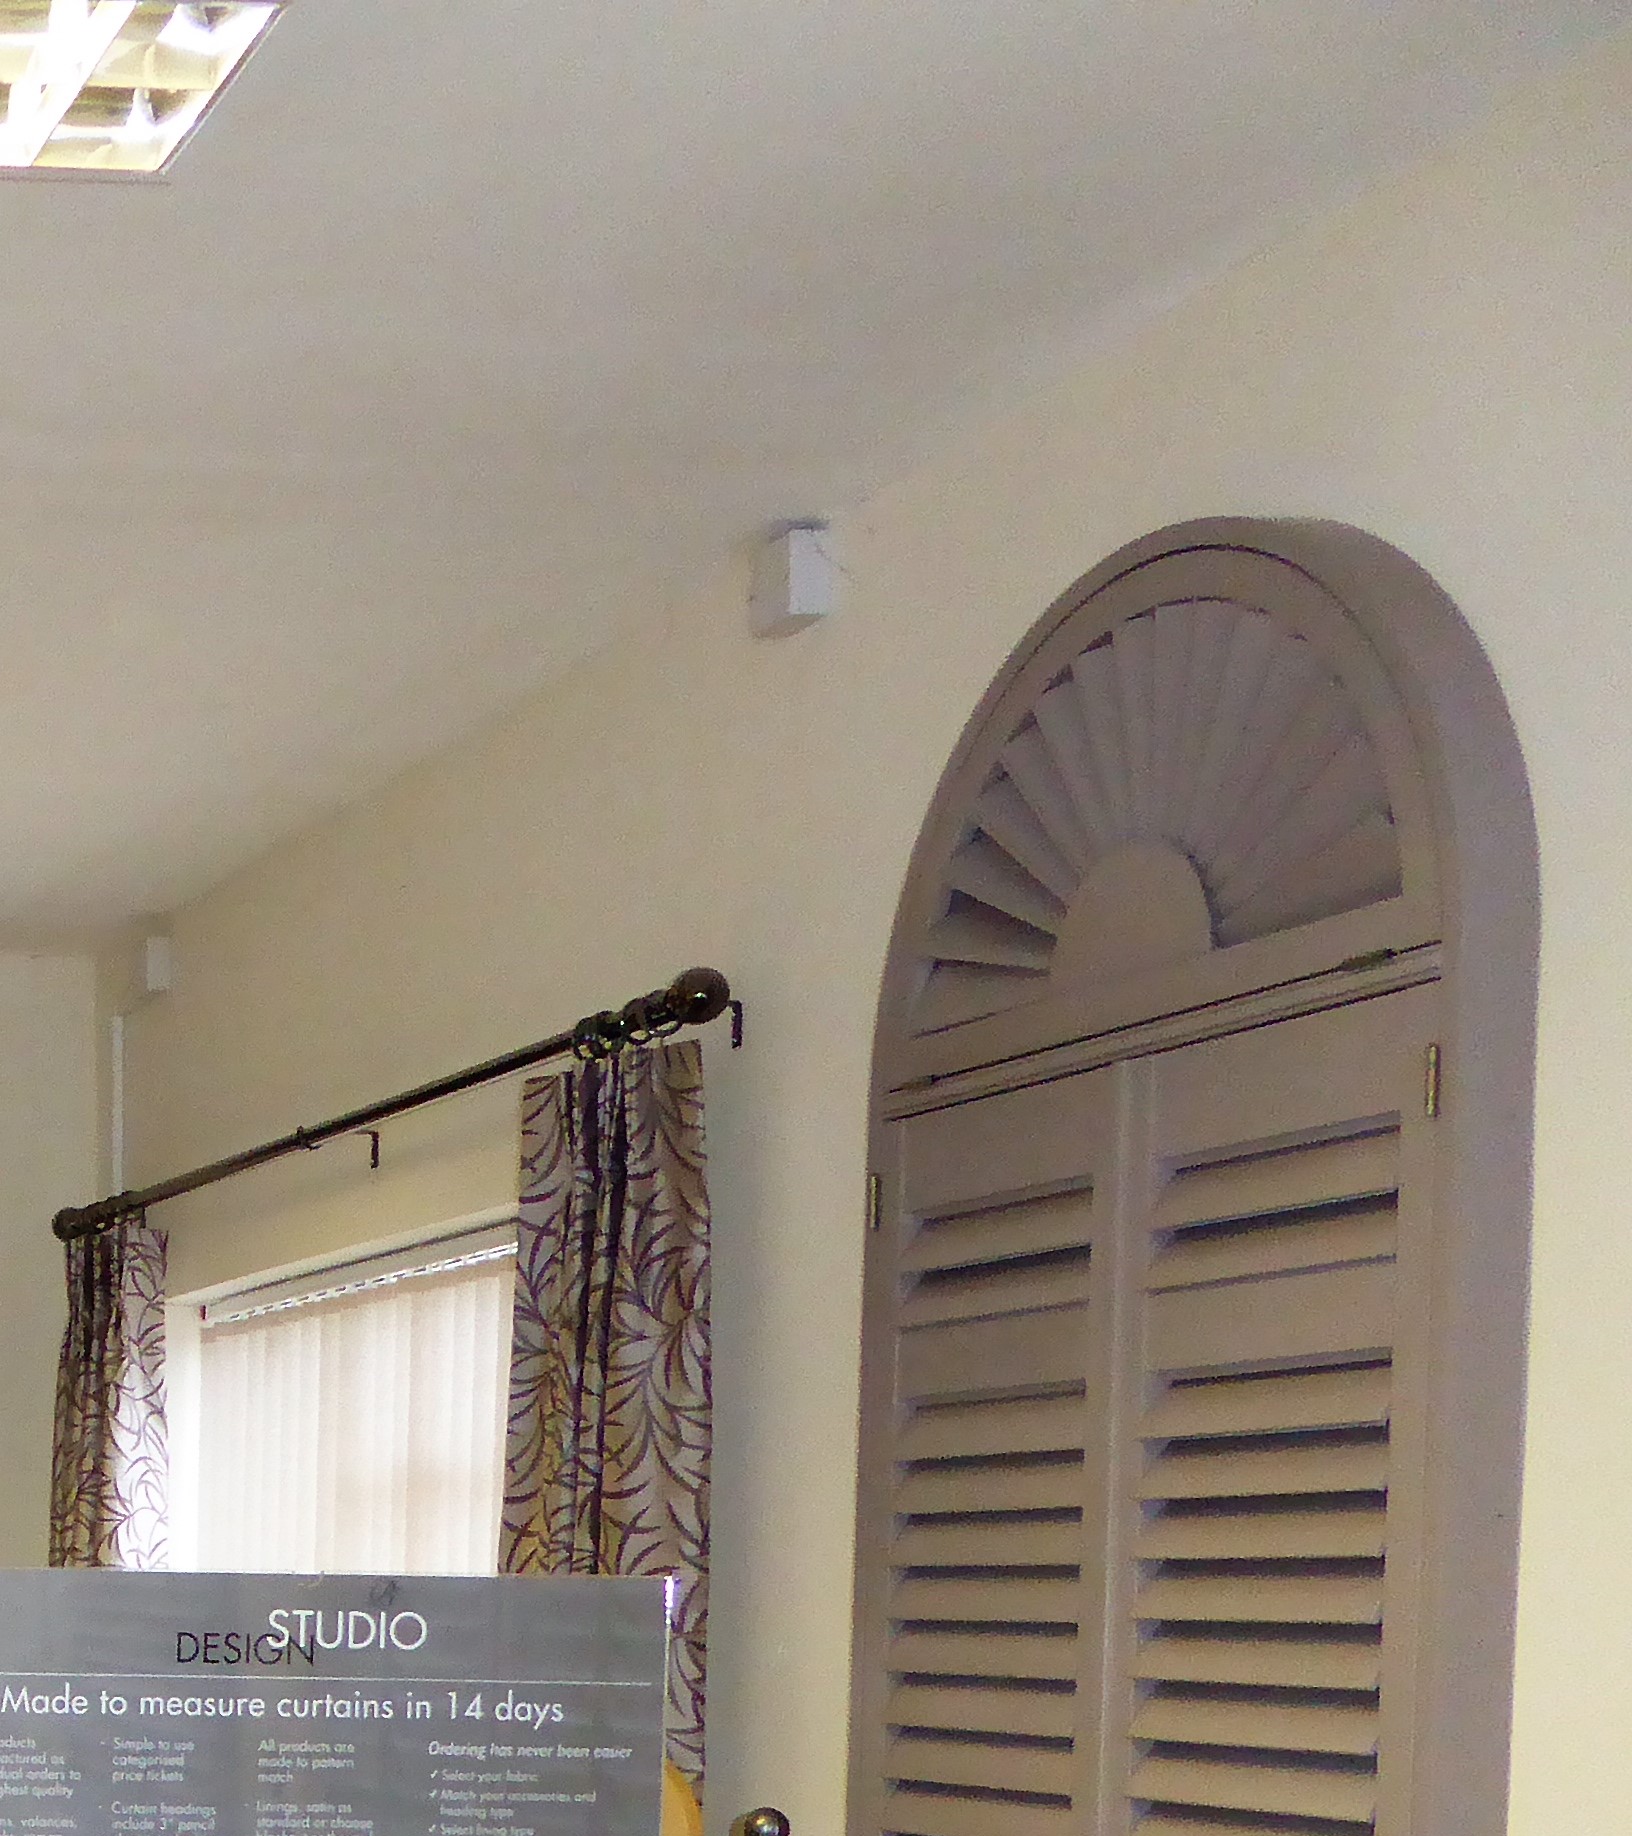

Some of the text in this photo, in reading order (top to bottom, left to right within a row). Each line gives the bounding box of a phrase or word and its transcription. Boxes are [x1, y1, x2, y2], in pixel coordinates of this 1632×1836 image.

[176, 1609, 428, 1665] DESIGN STUDIO
[0, 1683, 564, 1724] Made to measure curtains in 14 days
[113, 1737, 154, 1750] Simple
[158, 1739, 170, 1750] to
[257, 1739, 355, 1754] All products are
[428, 1741, 486, 1761] Ordering
[490, 1743, 513, 1756] has
[517, 1745, 553, 1757] never
[557, 1744, 590, 1758] been
[258, 1757, 354, 1770] made to pattern
[69, 1770, 81, 1780] to
[147, 1770, 184, 1782] tickets
[258, 1772, 293, 1783] match
[32, 1782, 73, 1799] quality
[575, 1790, 597, 1802] and
[161, 1802, 216, 1818] headings
